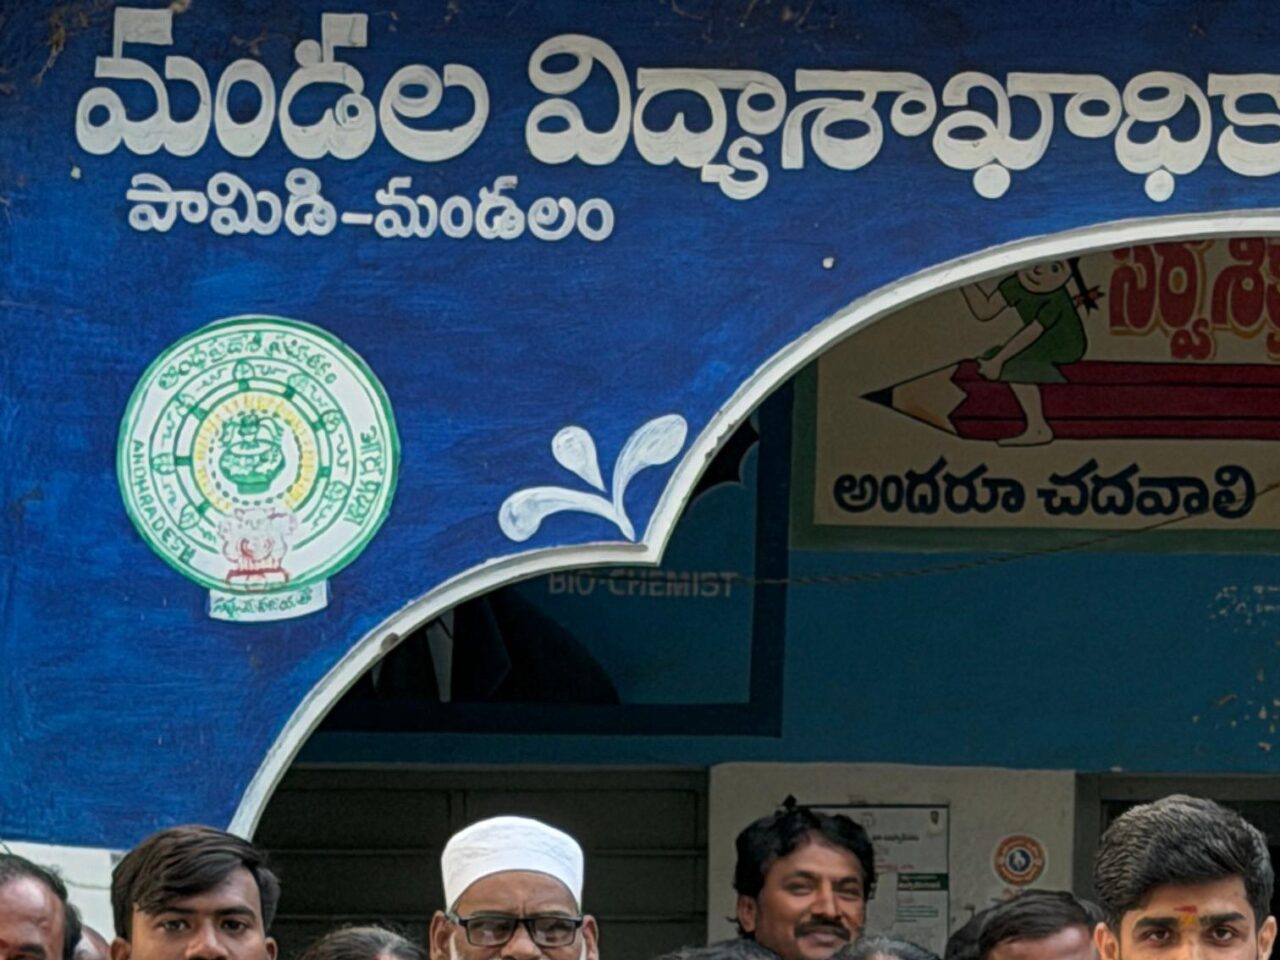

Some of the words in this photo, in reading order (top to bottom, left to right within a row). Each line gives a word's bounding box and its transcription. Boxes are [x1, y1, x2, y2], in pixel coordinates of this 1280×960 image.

[75, 8, 490, 162] మండల
[833, 455, 1026, 515] అందరూ
[1036, 458, 1257, 519] చదవాలి
